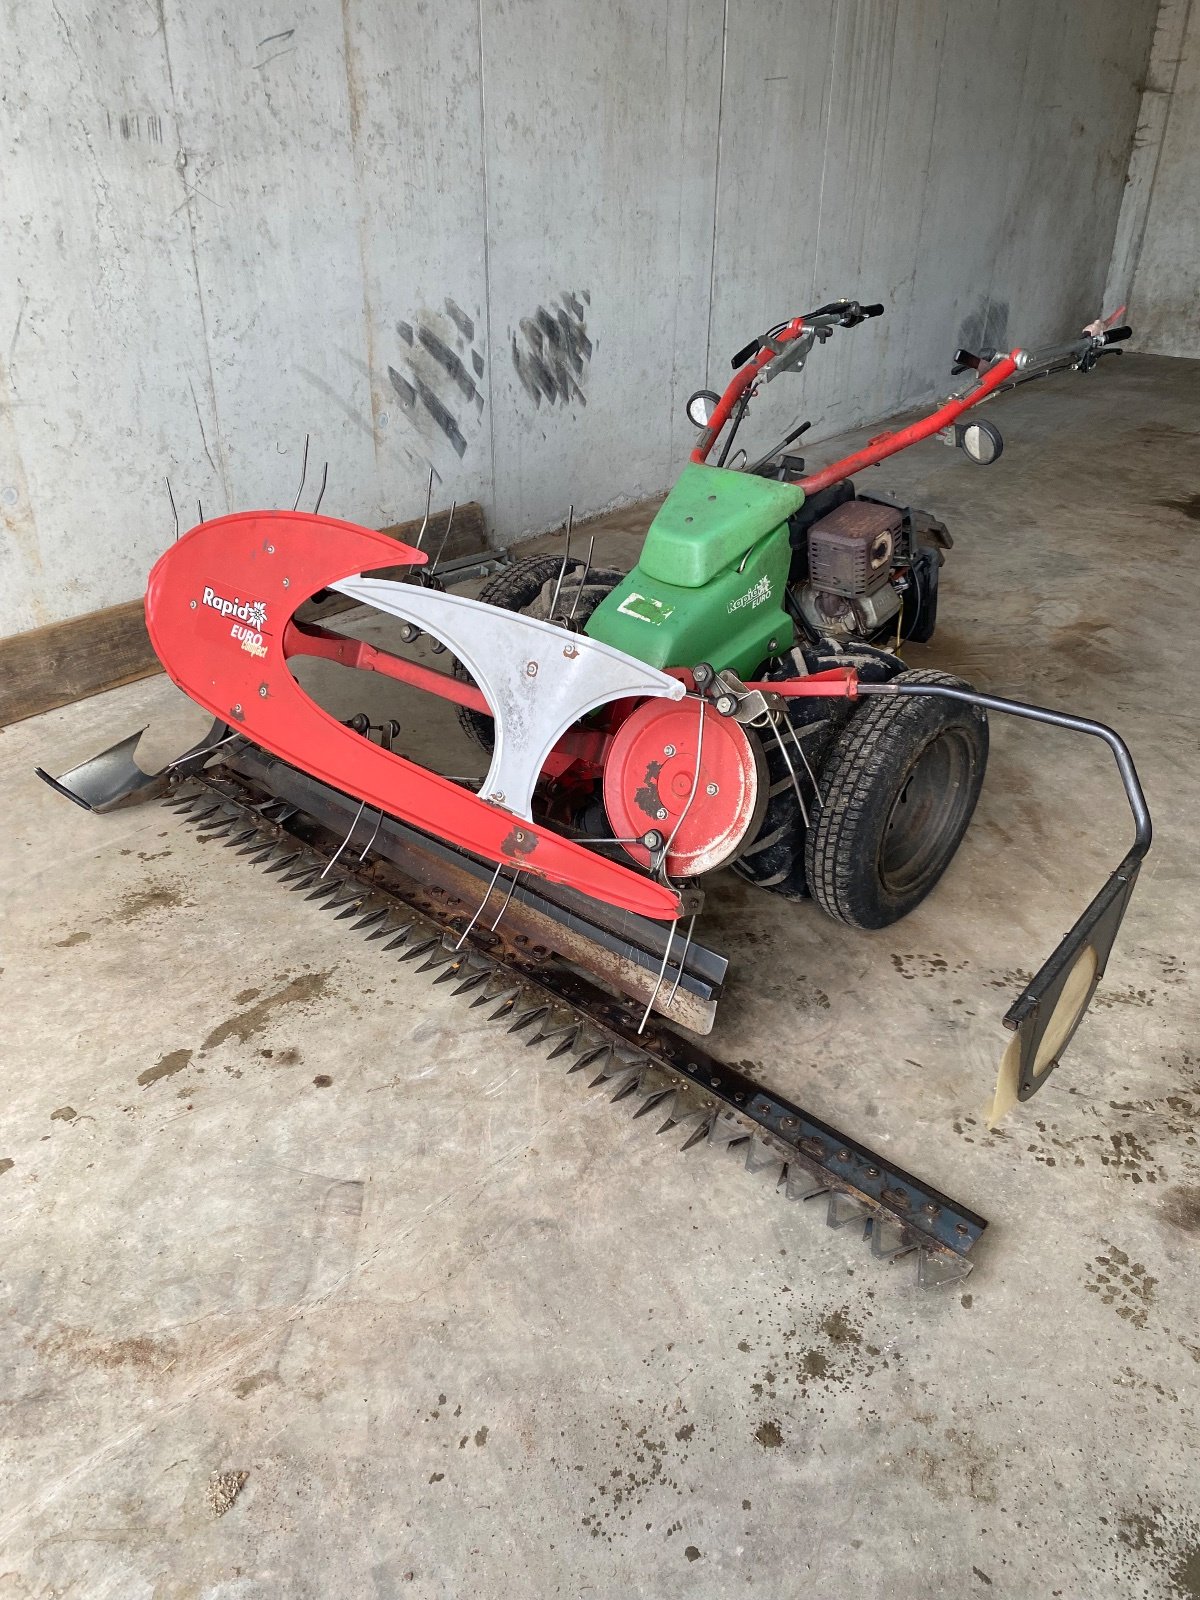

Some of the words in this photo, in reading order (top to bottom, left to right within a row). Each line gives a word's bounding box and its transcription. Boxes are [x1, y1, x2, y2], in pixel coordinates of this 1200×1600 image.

[203, 586, 250, 621] Rapid
[727, 584, 760, 614] Rapid
[751, 590, 772, 609] EURO
[230, 624, 263, 646] EURO
